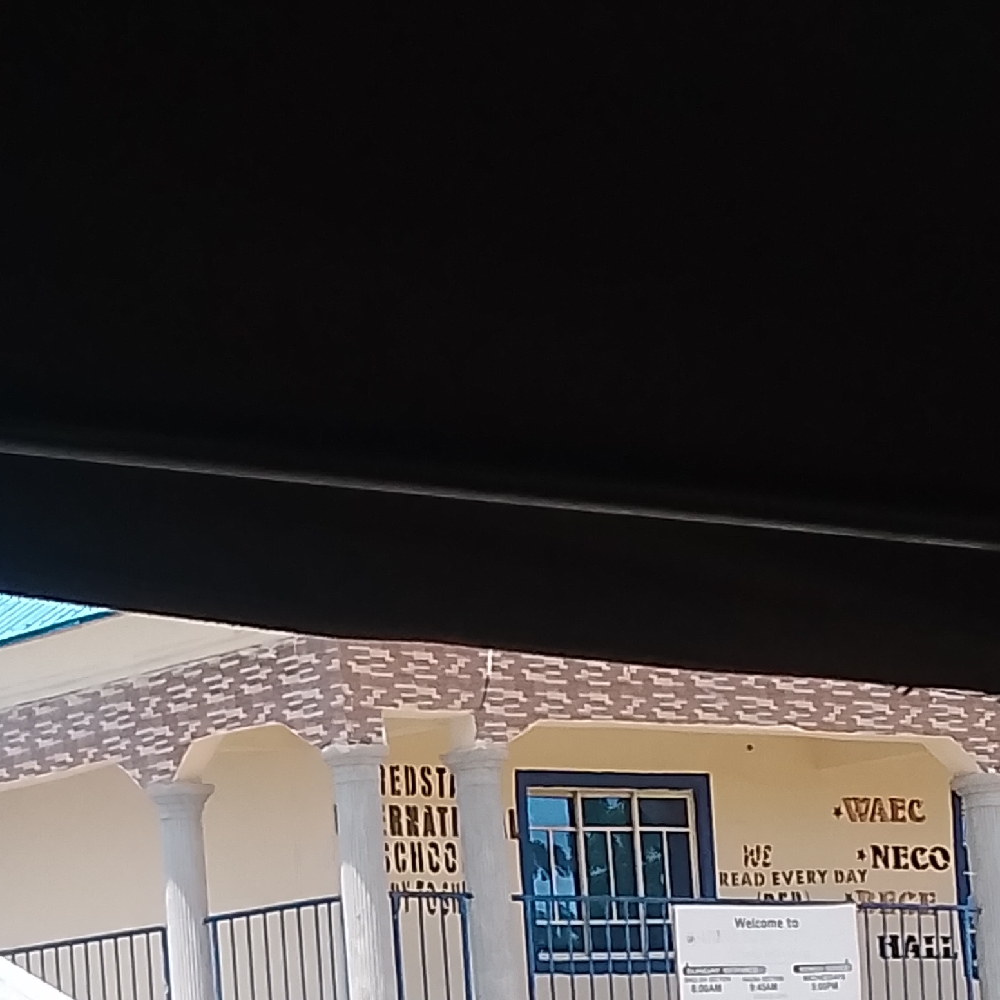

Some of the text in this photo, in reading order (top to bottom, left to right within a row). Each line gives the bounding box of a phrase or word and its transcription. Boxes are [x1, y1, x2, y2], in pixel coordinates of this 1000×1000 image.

[842, 797, 925, 823] WAEC
[744, 844, 772, 868] WE
[870, 844, 950, 870] NECO
[720, 868, 867, 887] READ EVERY DAY
[735, 917, 799, 928] Welcome to
[877, 934, 958, 959] HALL
